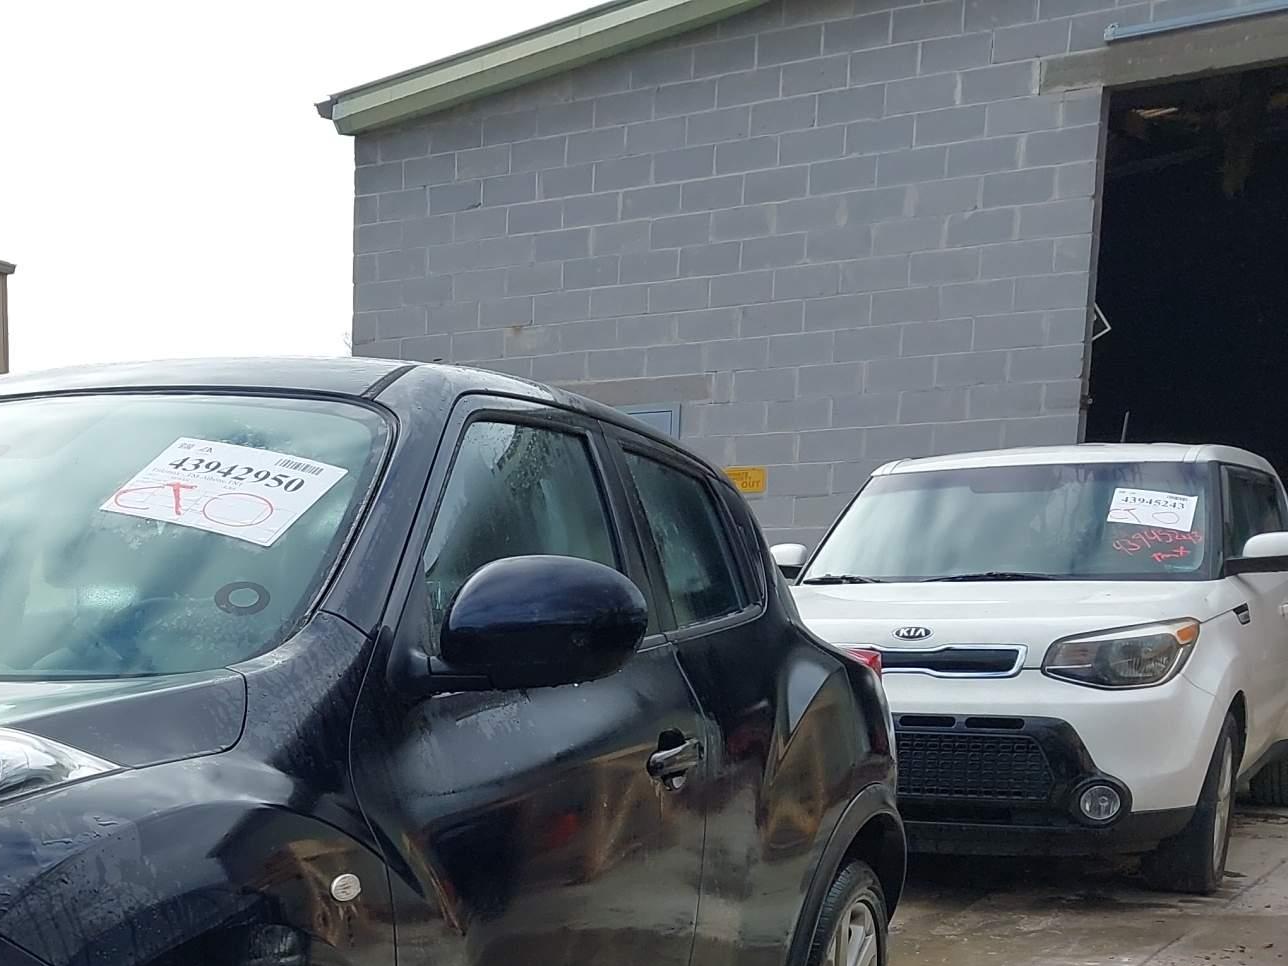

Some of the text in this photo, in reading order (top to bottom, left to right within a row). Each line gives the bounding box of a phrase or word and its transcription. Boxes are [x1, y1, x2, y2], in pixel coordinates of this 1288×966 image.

[169, 456, 306, 493] 43942950
[1121, 496, 1185, 510] 43945243
[899, 627, 927, 637] KIA
